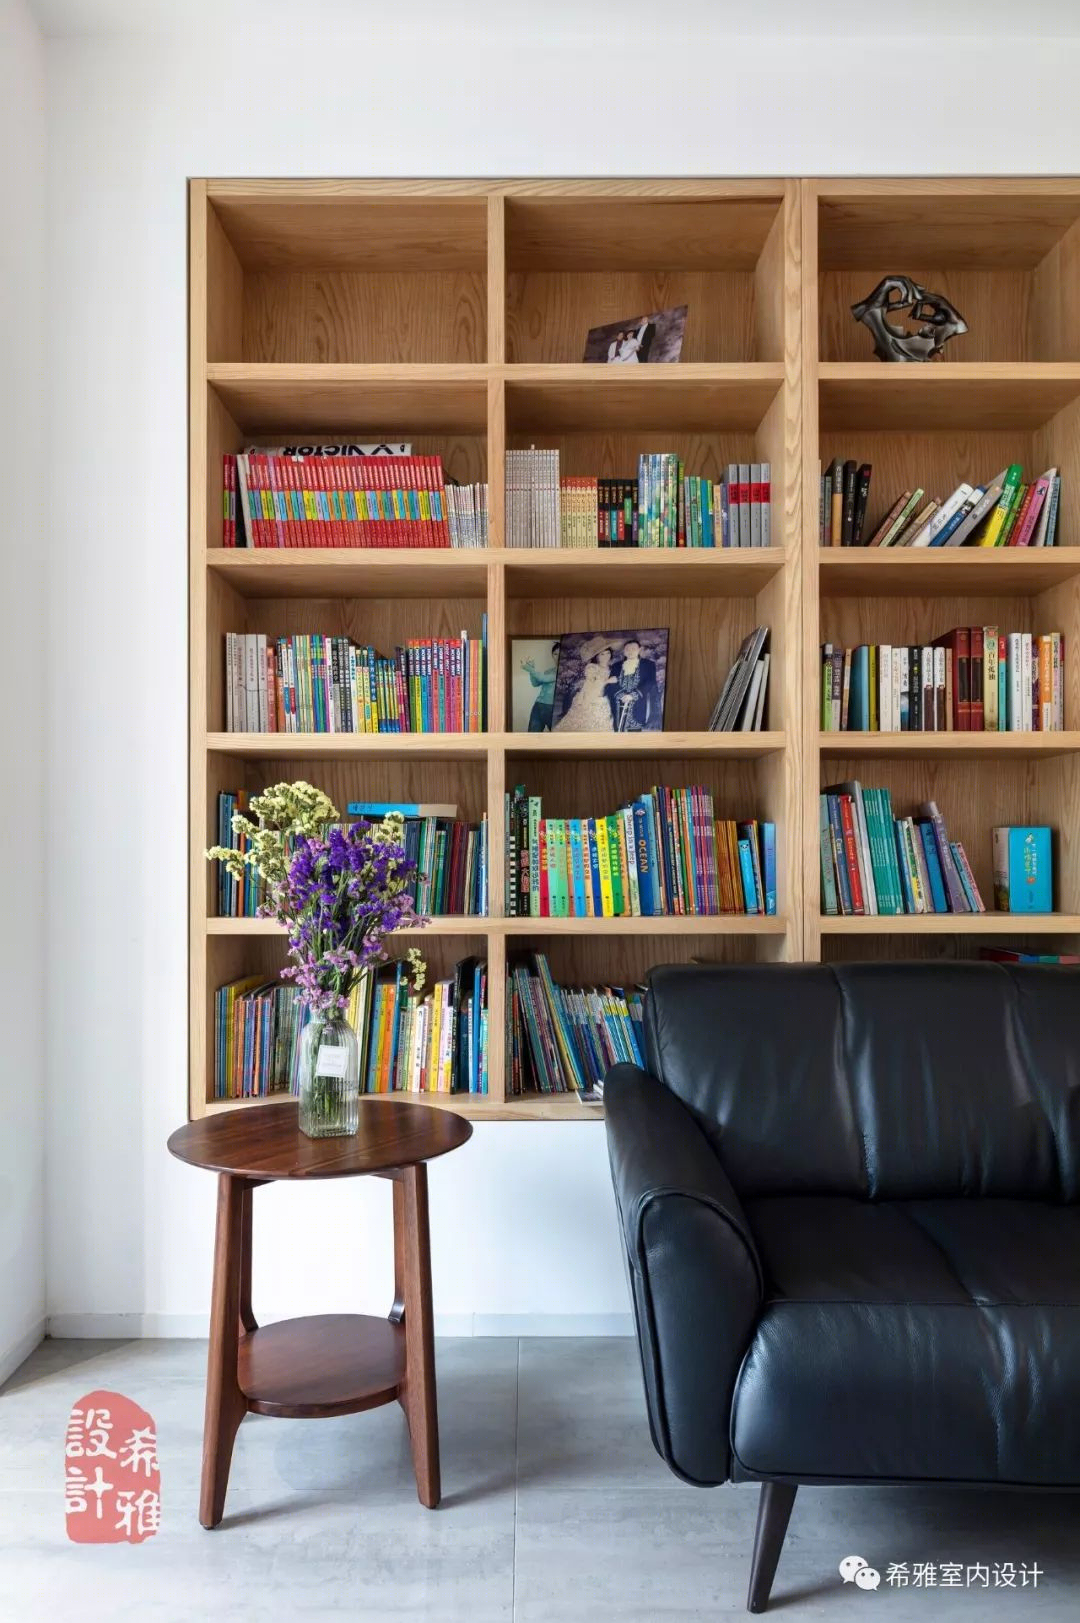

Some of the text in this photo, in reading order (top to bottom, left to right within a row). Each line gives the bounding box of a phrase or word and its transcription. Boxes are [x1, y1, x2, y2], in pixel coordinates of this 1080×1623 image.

[283, 445, 366, 456] VICTOR
[987, 651, 996, 681] 百年孤独
[639, 839, 649, 873] OCEAN
